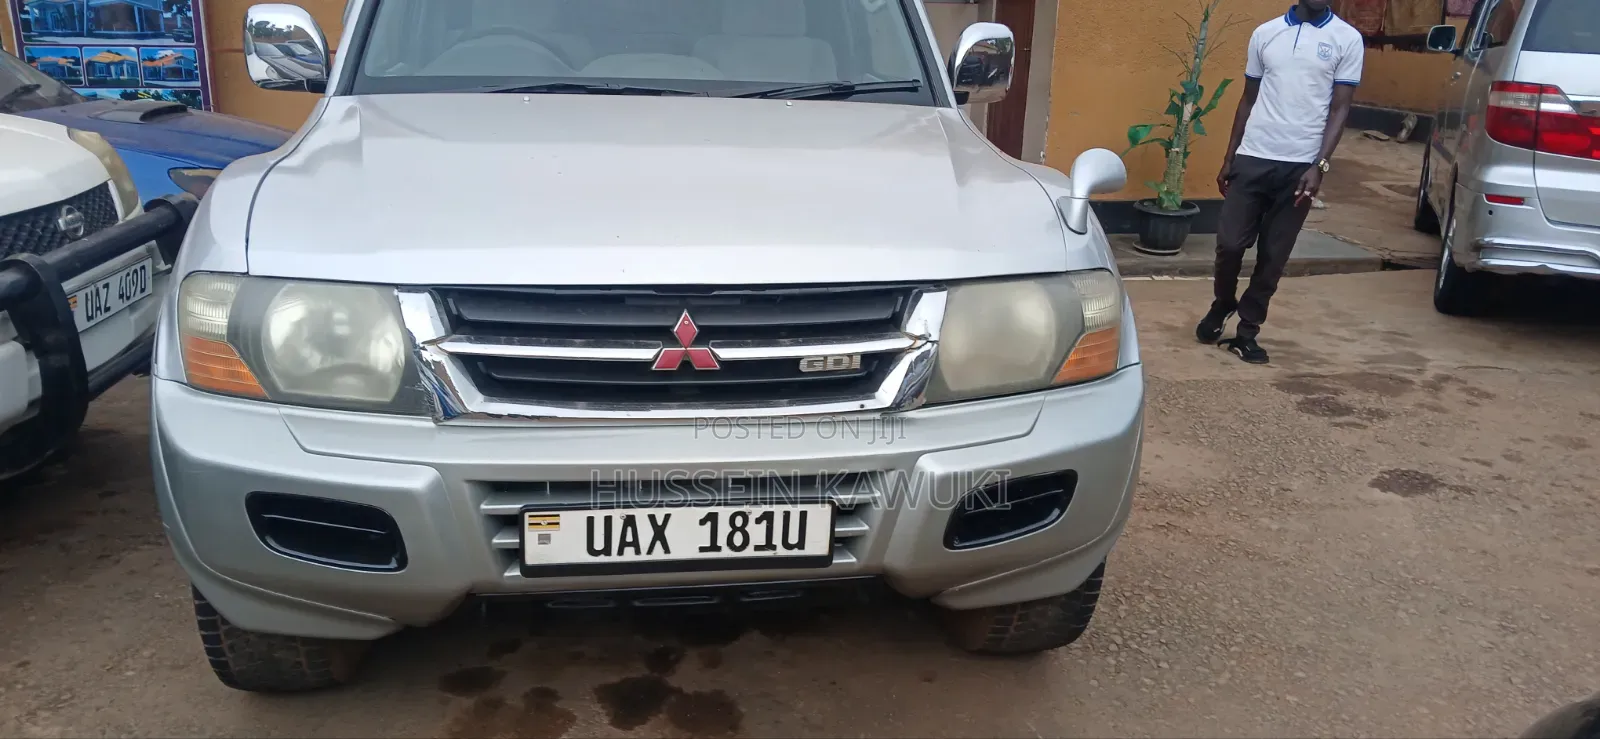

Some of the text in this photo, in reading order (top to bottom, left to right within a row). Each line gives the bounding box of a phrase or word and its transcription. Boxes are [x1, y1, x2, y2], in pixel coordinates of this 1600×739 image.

[84, 264, 147, 322] UAZ 409D
[799, 354, 861, 373] GDI
[586, 510, 808, 557] UAX 181U
